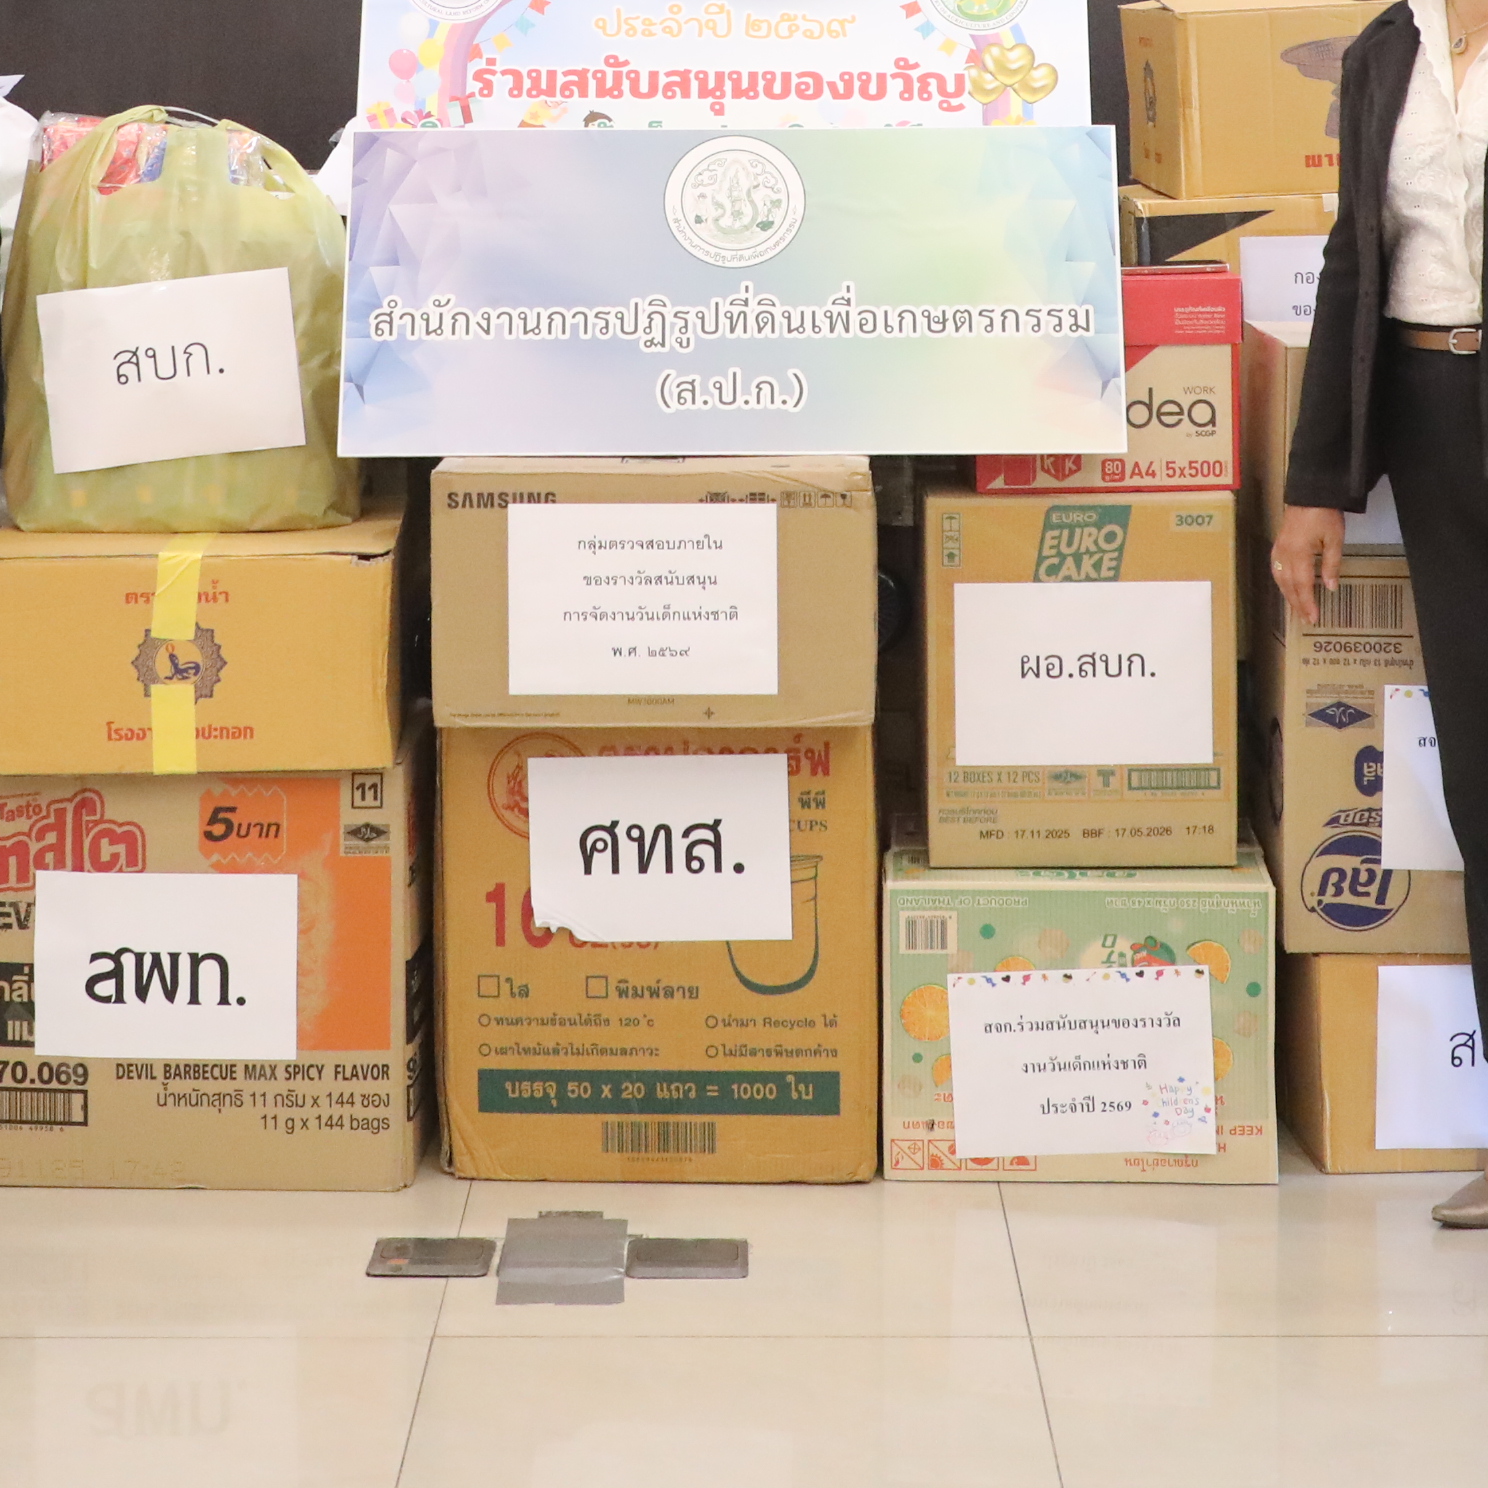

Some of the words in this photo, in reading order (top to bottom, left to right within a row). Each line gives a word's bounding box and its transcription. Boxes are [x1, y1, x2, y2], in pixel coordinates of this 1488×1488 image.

[594, 4, 732, 40] ประจำปี
[744, 13, 857, 41] ๒๕๖๙
[472, 55, 966, 116] ร่วมสนับสนุนของขวัญ
[371, 285, 1093, 349] สำนักงานการปฏิรูปที่ดินเพื่อเกษตรกรรม
[113, 341, 225, 385] สบก.
[657, 370, 806, 411] (ส.ป.ก.)
[1183, 386, 1216, 395] WORK
[1127, 387, 1217, 429] dea
[1105, 461, 1122, 473] 80
[1129, 461, 1157, 479] A4
[1165, 460, 1223, 479] 5x500
[1051, 511, 1097, 524] EURO
[1174, 513, 1214, 527] 3007
[577, 535, 724, 554] กลุ่มตรวจสอบภายใน
[1042, 524, 1124, 557] EURO
[1038, 551, 1119, 583] CAKE
[583, 569, 718, 589] ของรางวัลสนับสนุน
[563, 603, 739, 623] การจัดงานวันเด็กแห่งชาติ
[611, 644, 642, 659] พ.ศ.
[647, 644, 691, 659] ๒๕๖๙
[1313, 641, 1403, 653] 320039026
[1020, 651, 1157, 680] ผอ.สบก.
[1418, 737, 1437, 748] สจ
[947, 770, 961, 784] 12
[963, 770, 994, 784] BOXES
[996, 770, 1004, 784] X
[1007, 770, 1020, 784] 12
[1022, 770, 1041, 784] PCS
[355, 782, 380, 803] 11
[1014, 827, 1070, 840] 17.11.2025
[1114, 825, 1173, 838] 17.05.2026
[1185, 824, 1215, 836] 17:18
[578, 818, 746, 876] ศทส.
[898, 897, 951, 908] THAILAND
[955, 897, 971, 908] OF
[976, 897, 1029, 908] PRODUCT
[85, 947, 246, 1006] สพท.
[505, 977, 530, 1000] ใส
[615, 975, 700, 1000] พิมพ์ลาย
[617, 1016, 640, 1028] 120
[984, 1012, 1182, 1038] สจก.ร่วมสนับสนุนของรางวัล
[115, 1062, 158, 1081] DEVIL
[163, 1062, 238, 1082] BARBECUE
[243, 1062, 278, 1082] MAX
[284, 1063, 325, 1082] SPICY
[333, 1063, 391, 1082] FLAVOR
[1021, 1053, 1148, 1076] งานวันเด็กแห่งชาติ
[156, 1083, 245, 1113] น้ำหนักสุทธิ
[250, 1090, 269, 1108] 11
[274, 1087, 307, 1109] กรัม
[311, 1094, 322, 1108] x
[326, 1090, 357, 1109] 144
[360, 1091, 391, 1110] ซอง
[505, 1078, 558, 1107] บรรจุ
[566, 1082, 592, 1100] 50
[601, 1086, 612, 1099] x
[621, 1082, 646, 1100] 20
[656, 1082, 697, 1100] แถว
[731, 1082, 778, 1101] 1000
[785, 1074, 814, 1101] ใบ
[1039, 1096, 1096, 1117] ประจำปี
[1100, 1099, 1133, 1114] 2569
[1174, 1107, 1195, 1119] Day
[261, 1114, 280, 1131] 11
[284, 1118, 296, 1134] g
[301, 1118, 312, 1131] x
[315, 1114, 345, 1131] 144
[349, 1114, 391, 1135] bags
[1229, 1125, 1263, 1136] KEEP
